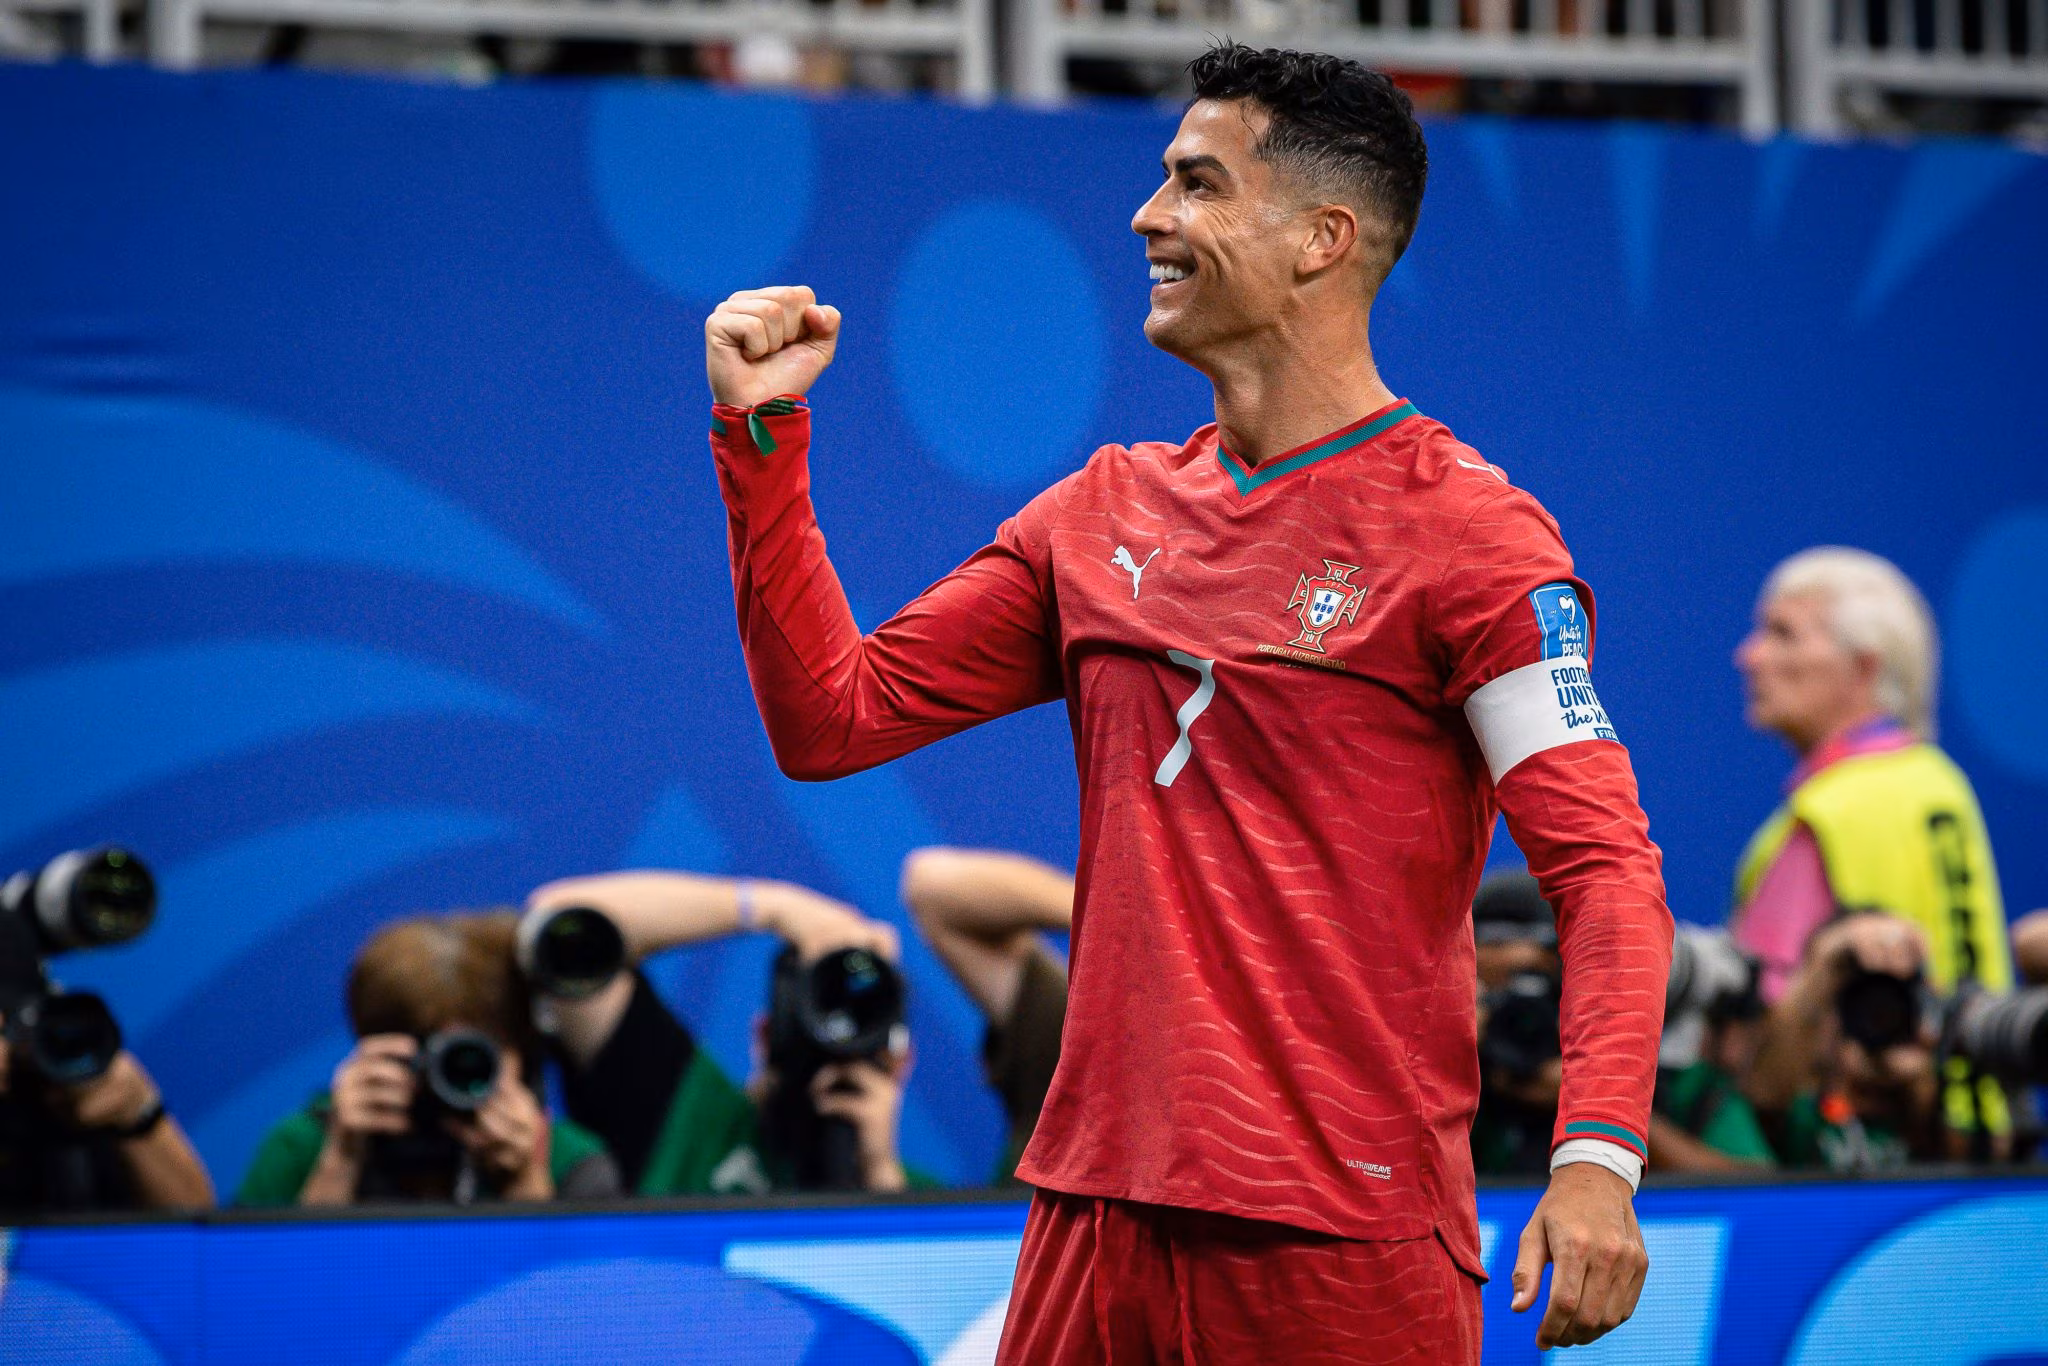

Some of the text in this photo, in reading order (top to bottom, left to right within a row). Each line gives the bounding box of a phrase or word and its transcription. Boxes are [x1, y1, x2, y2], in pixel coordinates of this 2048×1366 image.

[1256, 644, 1290, 656] PORTUGAL
[1556, 685, 1600, 708] UNIT
[1155, 650, 1215, 787] 7
[1561, 709, 1593, 729] the
[1346, 1159, 1392, 1175] ULTRAWEAVE
